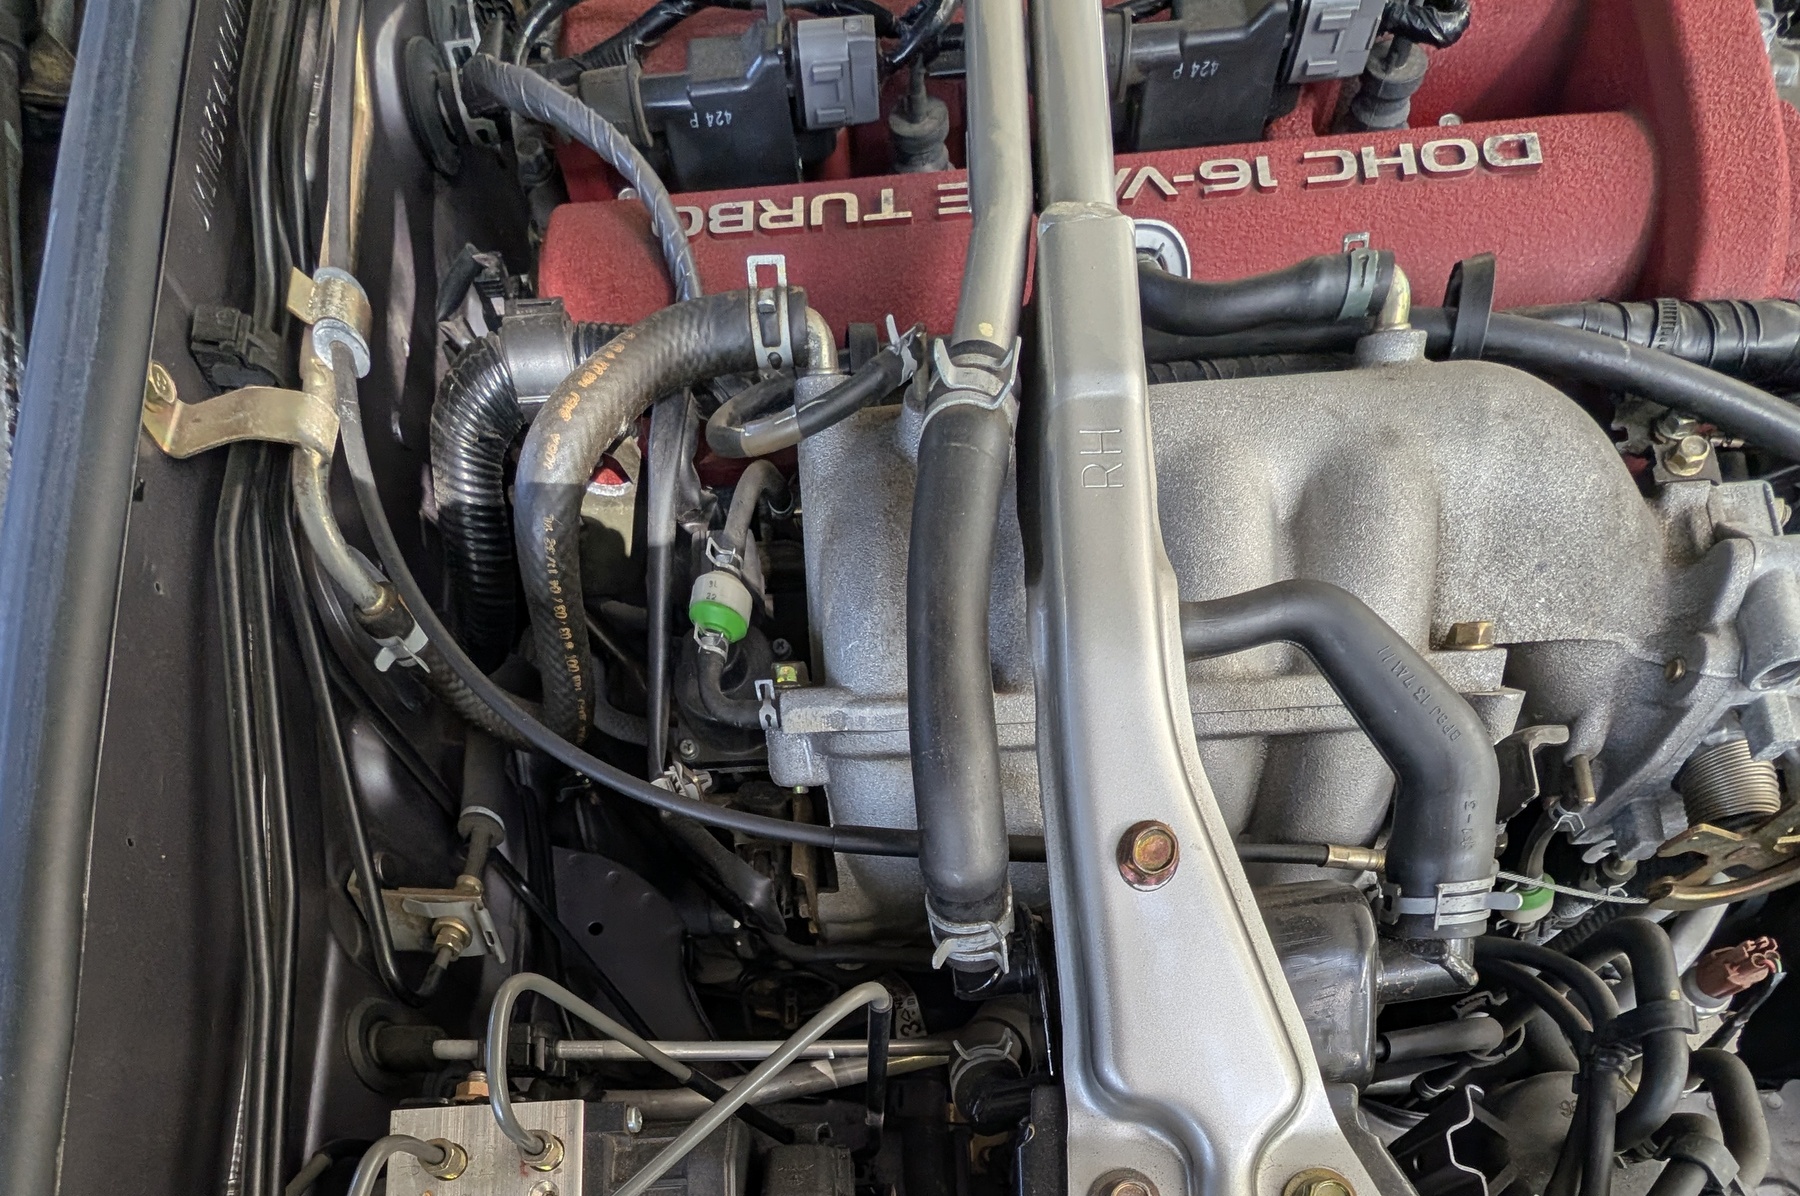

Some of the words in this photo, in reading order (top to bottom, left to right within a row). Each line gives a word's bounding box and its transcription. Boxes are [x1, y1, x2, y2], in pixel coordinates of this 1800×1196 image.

[1190, 60, 1220, 78] 424
[705, 110, 732, 128] 424
[1303, 133, 1543, 187] DOHC
[1080, 428, 1124, 490] RH
